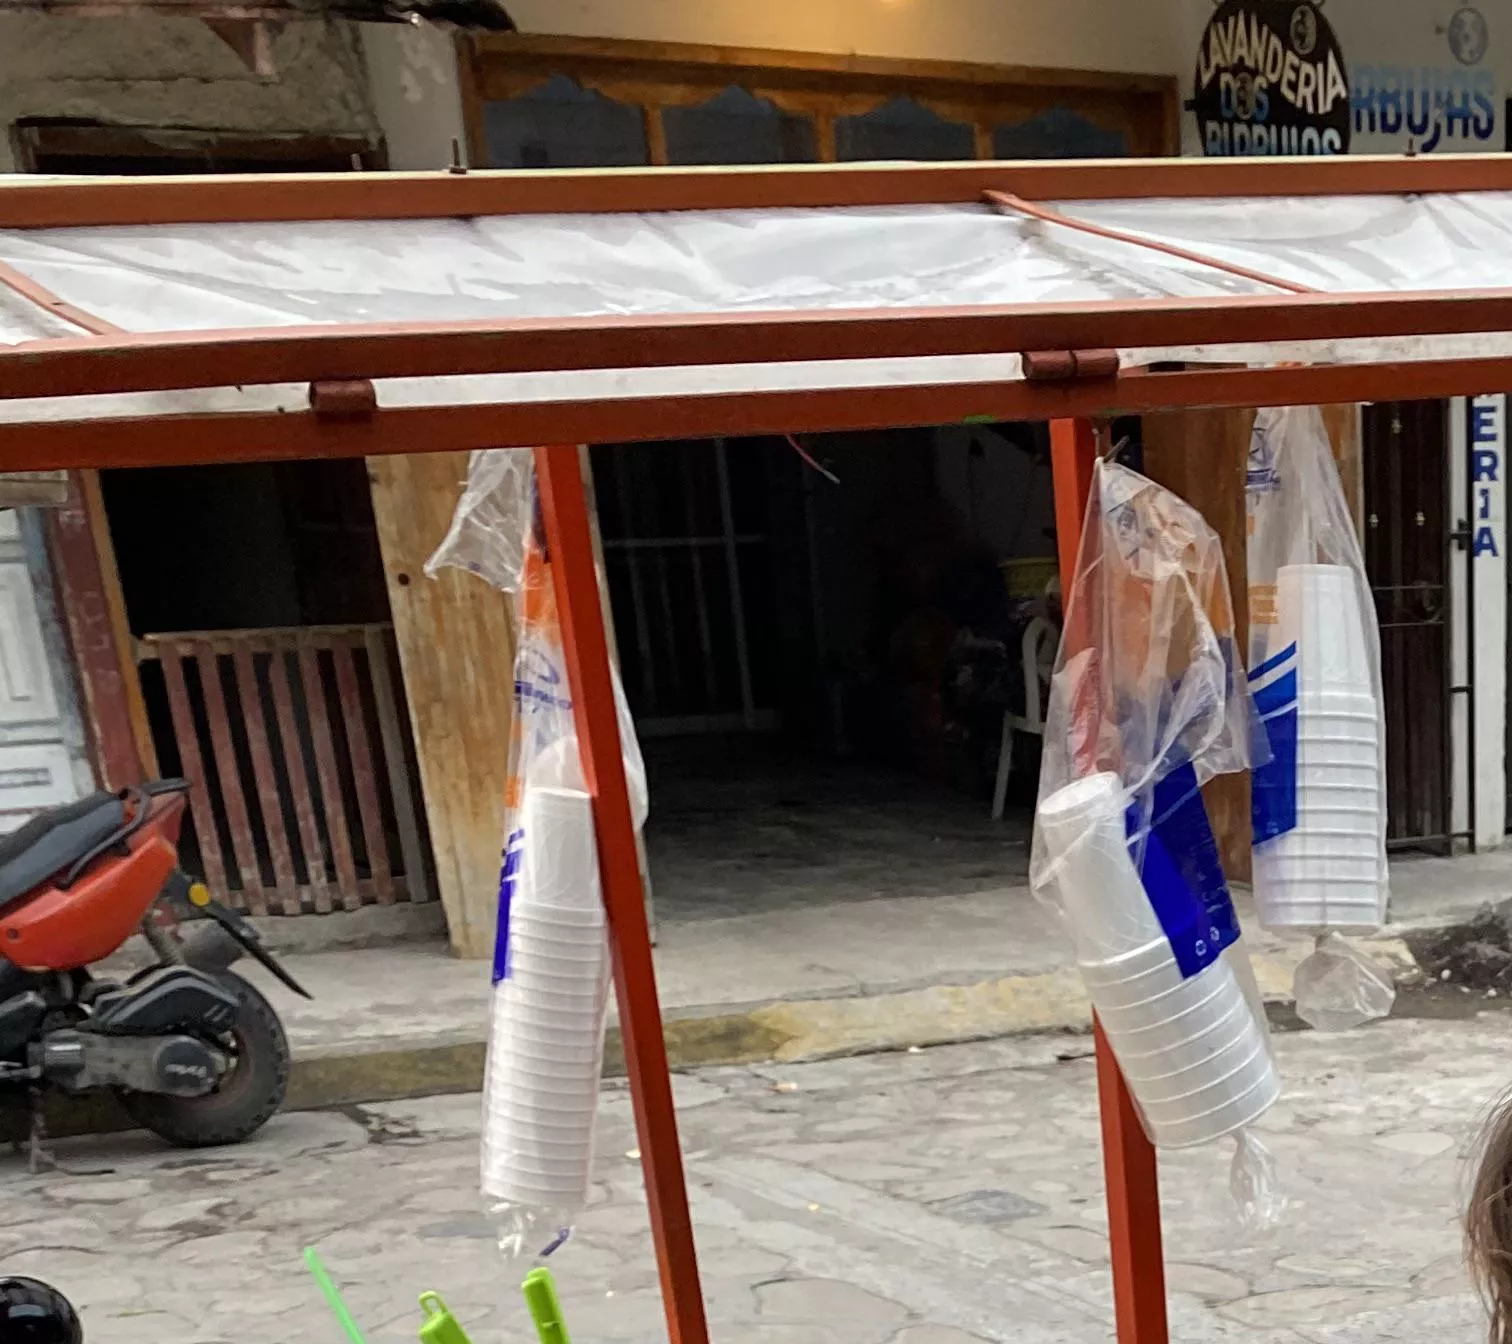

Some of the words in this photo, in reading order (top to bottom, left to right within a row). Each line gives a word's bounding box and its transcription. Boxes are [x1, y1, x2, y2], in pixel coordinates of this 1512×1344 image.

[1200, 9, 1347, 115] LAVANDERIA
[1351, 64, 1494, 153] RBUJAS
[1472, 400, 1499, 558] ERIA
